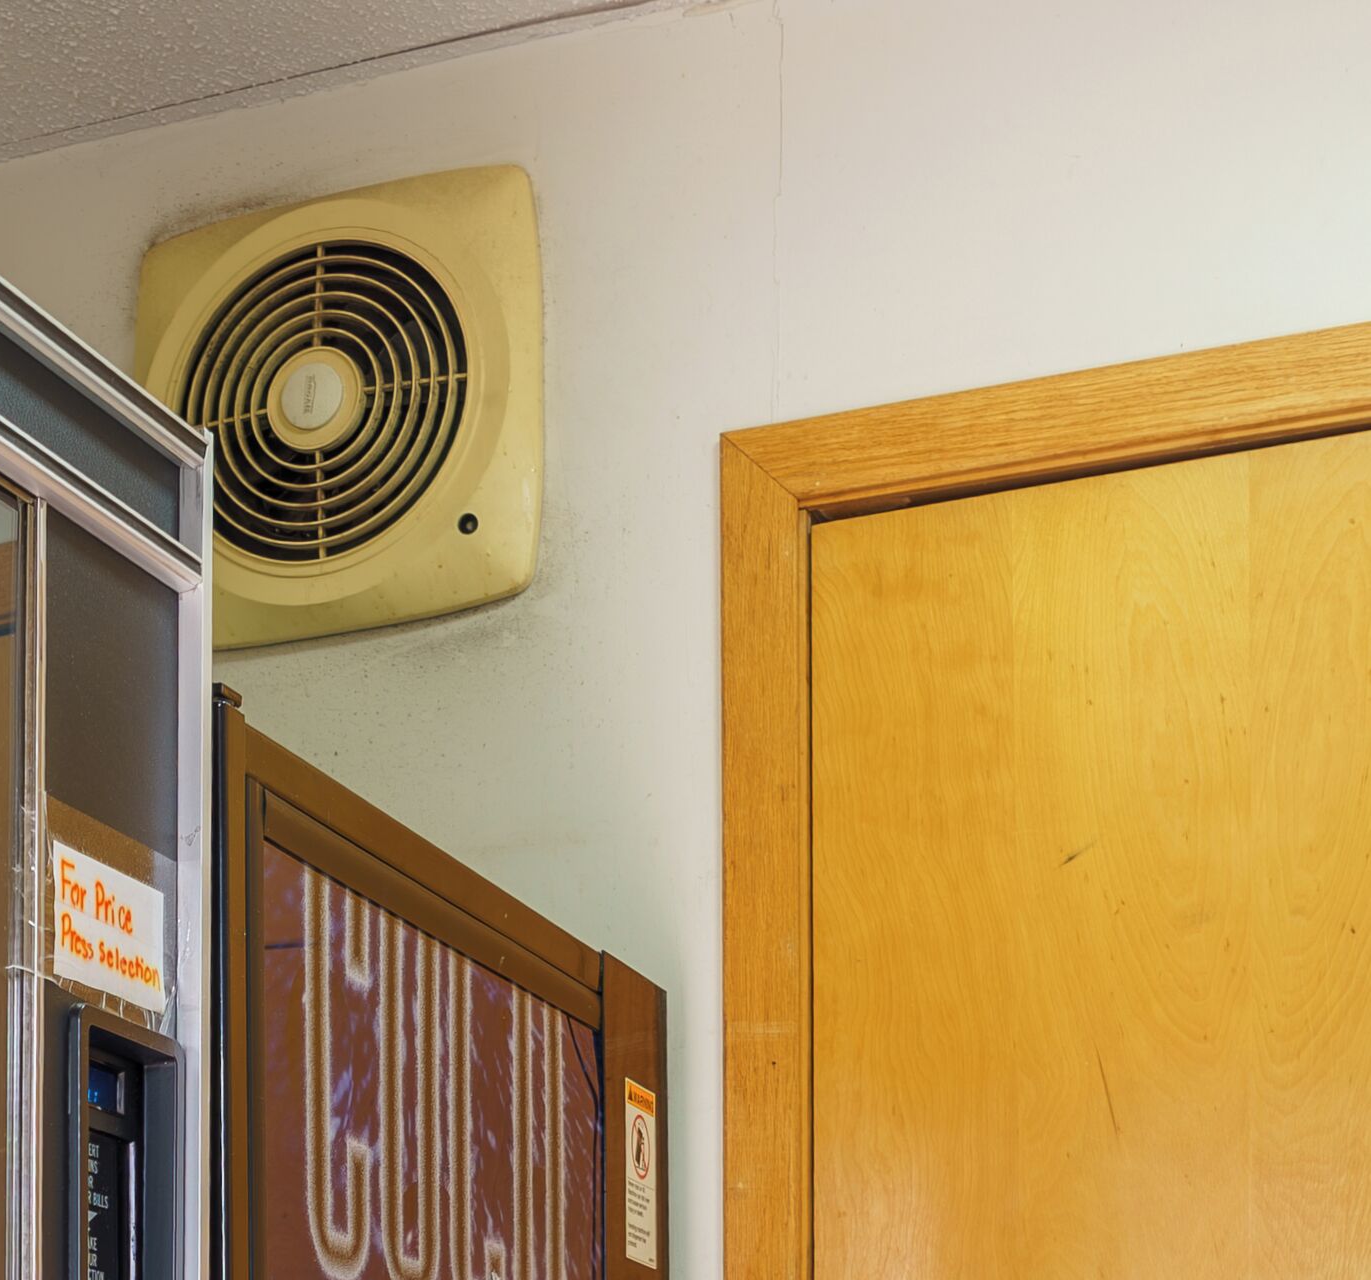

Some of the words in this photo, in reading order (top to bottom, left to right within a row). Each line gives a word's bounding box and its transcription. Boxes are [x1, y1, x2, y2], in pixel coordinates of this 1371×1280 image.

[60, 857, 87, 912] For
[94, 880, 133, 935] Price
[60, 912, 94, 960] Press
[99, 941, 161, 992] Selection
[93, 1192, 108, 1209] BILLS
